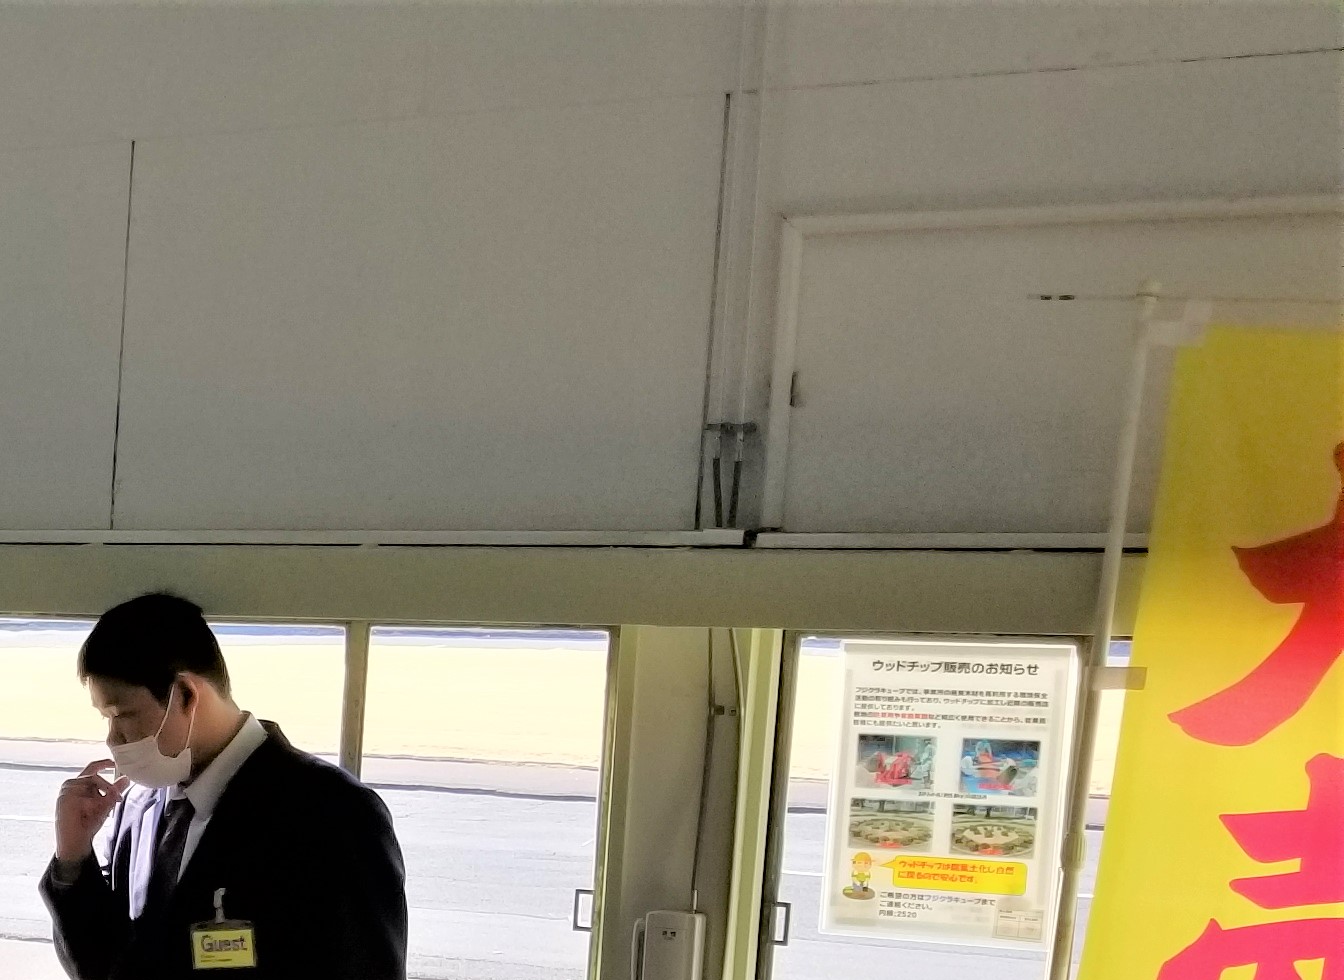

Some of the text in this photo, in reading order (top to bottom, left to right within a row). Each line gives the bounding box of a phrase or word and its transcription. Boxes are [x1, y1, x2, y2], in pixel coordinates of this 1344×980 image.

[872, 660, 1040, 676] ウッドチップ販売のお知らせ
[201, 935, 248, 952] Guest
